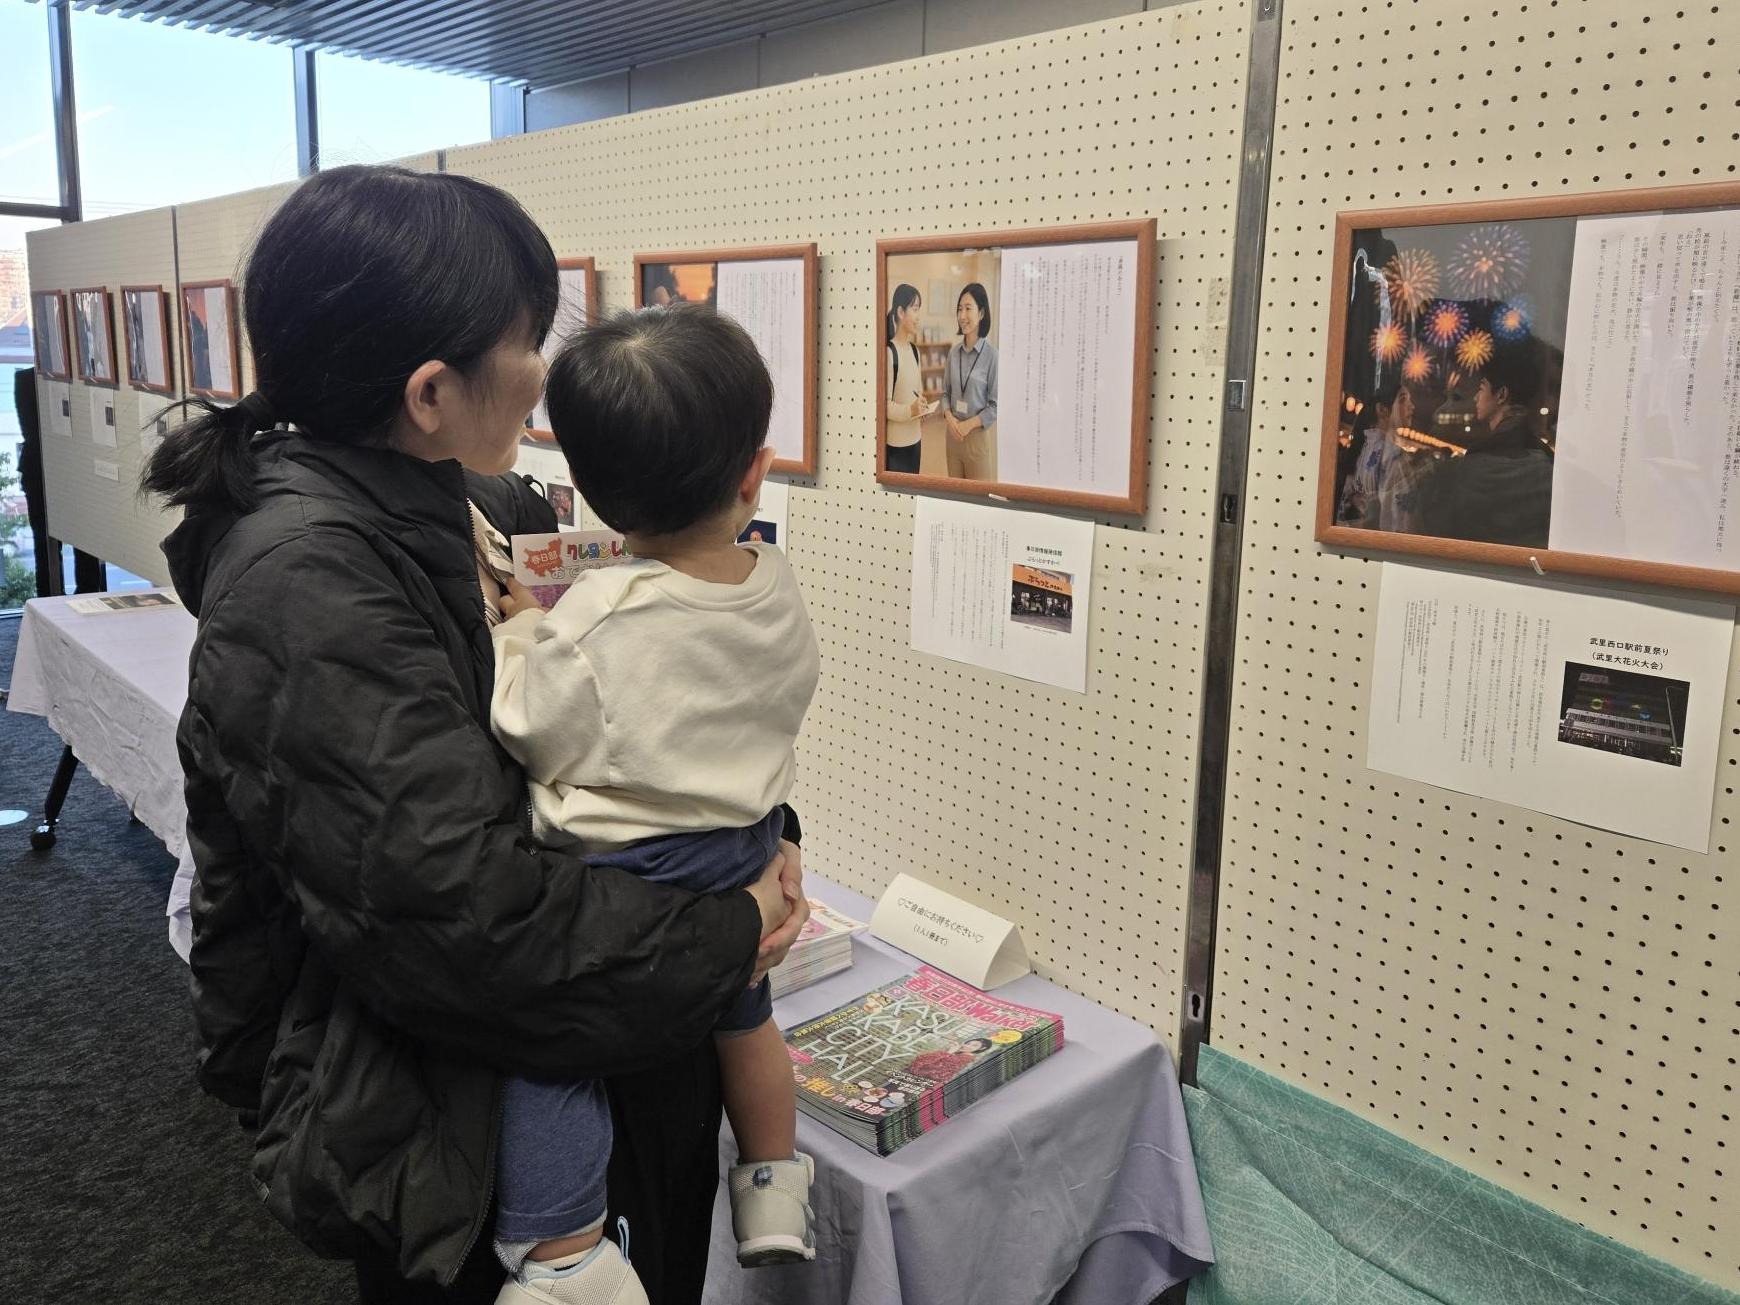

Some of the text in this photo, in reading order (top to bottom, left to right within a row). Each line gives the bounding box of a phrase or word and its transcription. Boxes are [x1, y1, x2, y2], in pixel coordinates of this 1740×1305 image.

[1589, 637, 1669, 657] 武里西口駅前夏祭り
[852, 1014, 940, 1051] KABE
[881, 995, 967, 1035] KASU
[799, 1039, 874, 1084] HALL
[826, 1025, 918, 1065] CITY
